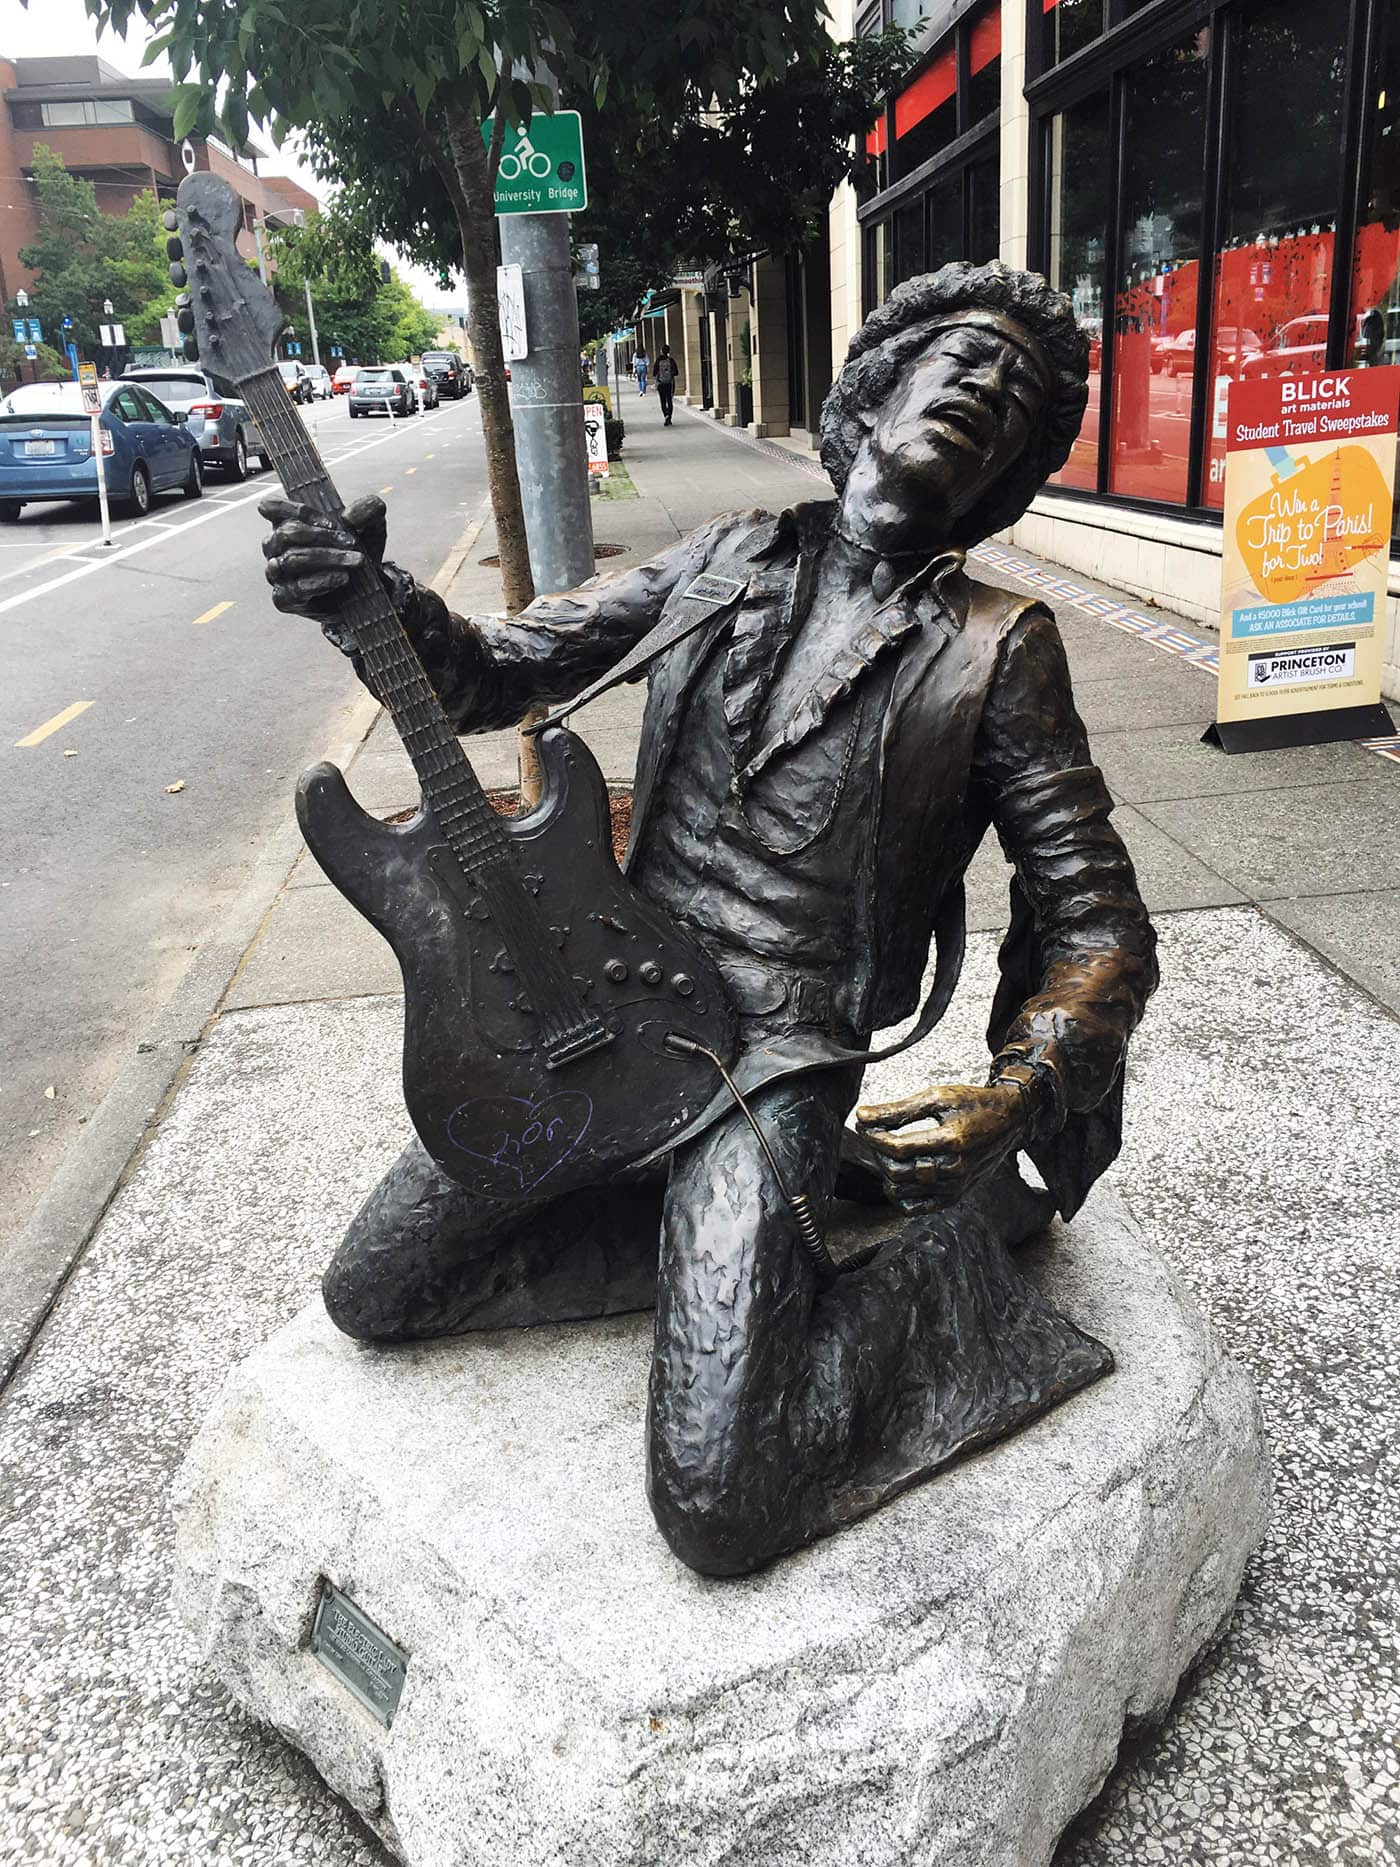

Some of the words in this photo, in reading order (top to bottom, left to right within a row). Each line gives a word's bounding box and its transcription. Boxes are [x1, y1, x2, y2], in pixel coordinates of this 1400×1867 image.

[494, 189, 541, 204] University
[548, 188, 578, 201] Bridge
[1282, 377, 1350, 402] BLICK
[585, 406, 602, 416] PEN
[1281, 403, 1297, 414] art
[1300, 399, 1350, 412] materials
[1236, 424, 1280, 442] Student
[1283, 417, 1317, 437] Travel
[1320, 411, 1390, 434] Sweepstakes
[1270, 489, 1307, 518] Win
[1311, 499, 1320, 512] a
[1247, 513, 1292, 552] Trip
[1298, 518, 1313, 540] to
[1314, 504, 1373, 542] Paris!
[1262, 552, 1285, 577] for
[1286, 543, 1323, 570] Two!
[1240, 612, 1251, 622] And
[1282, 608, 1296, 616] Blick
[1309, 604, 1323, 613] Card
[1249, 623, 1263, 632] ASK
[1264, 621, 1274, 630] AN
[1275, 616, 1312, 629] ASSOCIATE
[1313, 615, 1326, 624] FOR
[1271, 653, 1346, 671] PRINCETON
[1272, 668, 1298, 680] ARTIST
[1300, 666, 1327, 678] BRUSH
